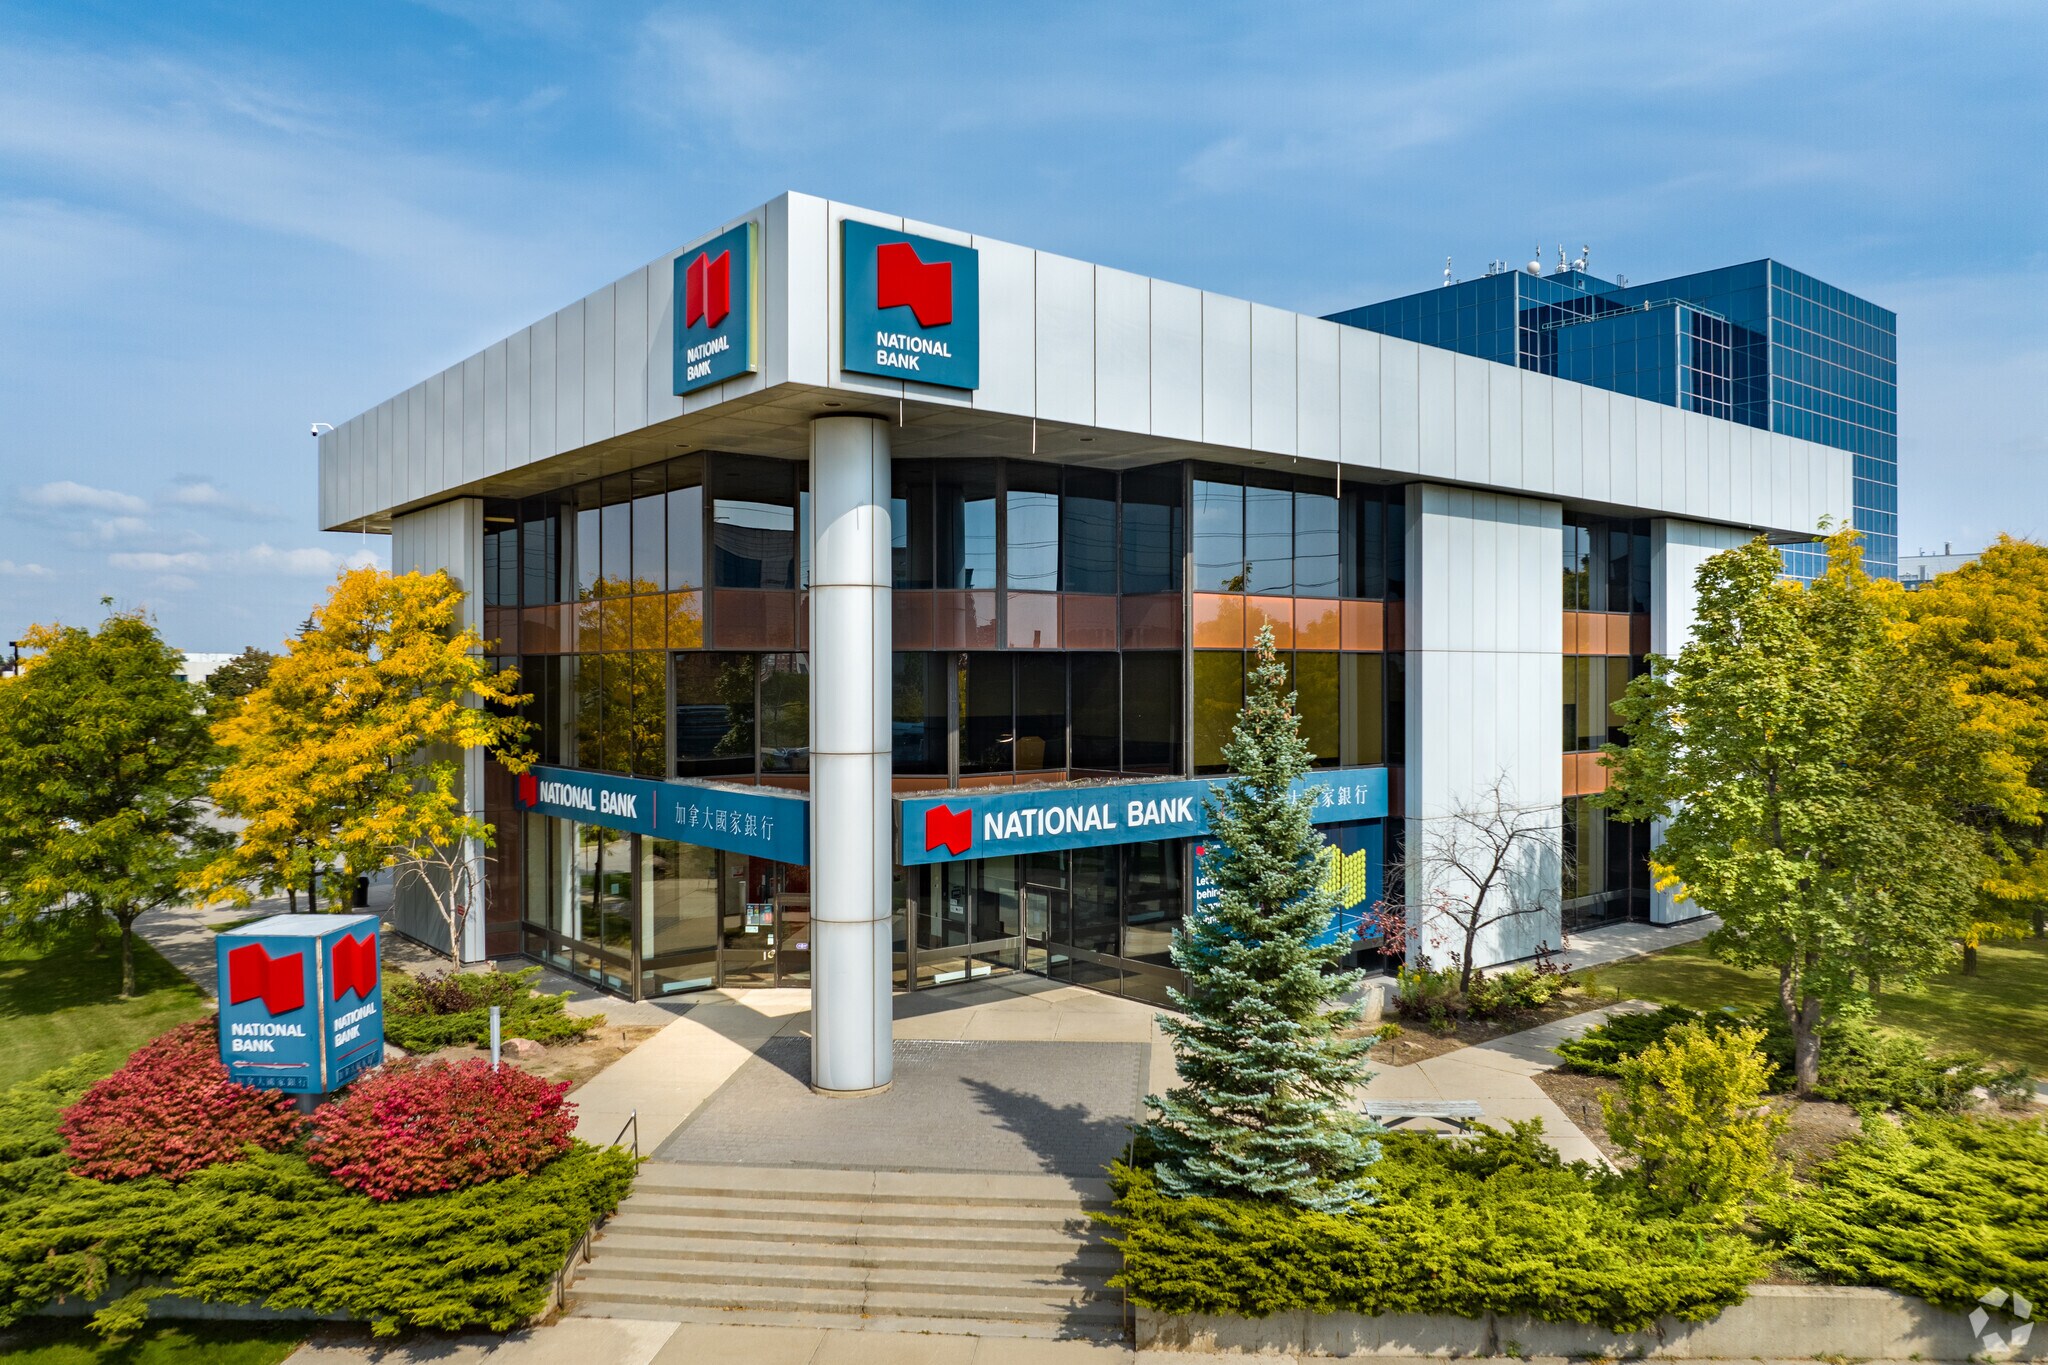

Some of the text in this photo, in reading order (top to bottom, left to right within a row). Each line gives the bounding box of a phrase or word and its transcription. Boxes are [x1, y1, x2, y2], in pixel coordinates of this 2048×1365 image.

[687, 335, 730, 364] NATIONAL
[877, 331, 952, 358] NATIONAL
[687, 362, 712, 382] BANK
[877, 349, 920, 371] BANK
[540, 780, 638, 819] NATIONAL BANK
[674, 801, 774, 841] 加拿大國家銀行
[984, 796, 1194, 841] NATIONAL BANK
[231, 1023, 306, 1037] NATIONAL
[334, 1002, 377, 1032] NATIONAL
[232, 1038, 275, 1052] BANK
[334, 1024, 361, 1048] BANK
